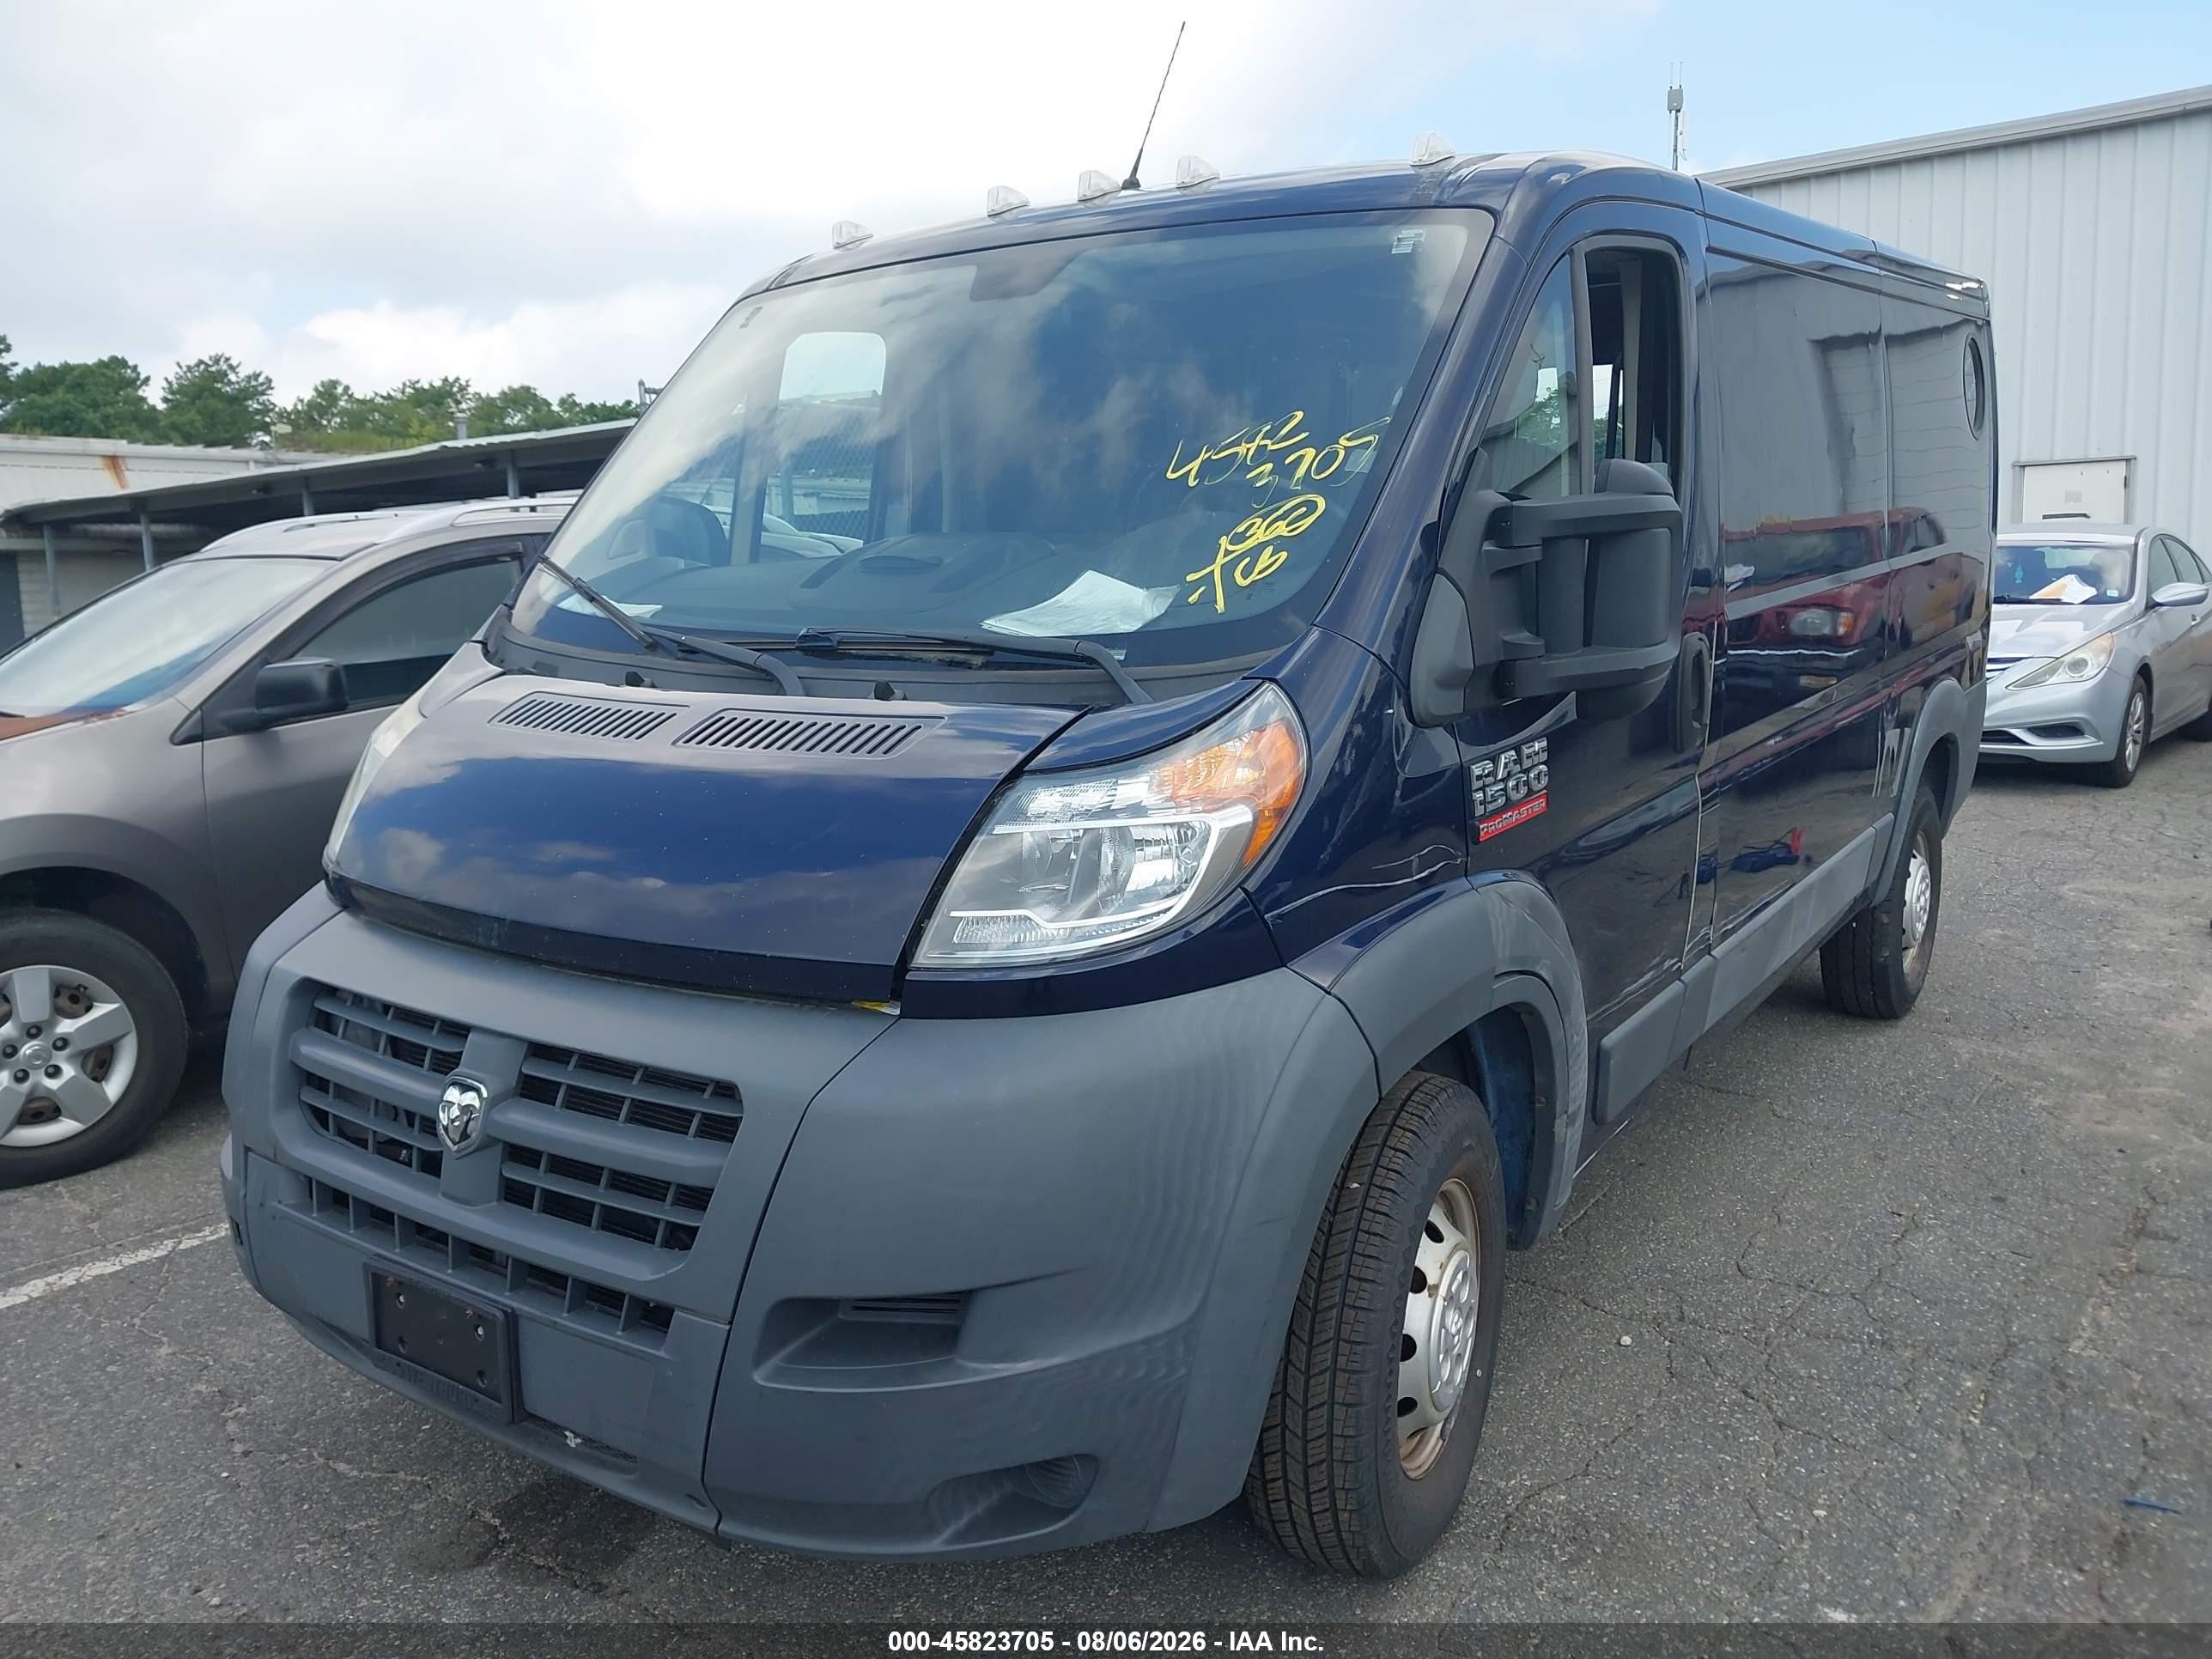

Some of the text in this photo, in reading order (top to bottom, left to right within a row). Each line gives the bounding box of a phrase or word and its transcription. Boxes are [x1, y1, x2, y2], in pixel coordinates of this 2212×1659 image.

[1469, 736, 1548, 790] RAM
[1472, 763, 1549, 817] 1500
[1479, 798, 1547, 836] PROMASTER
